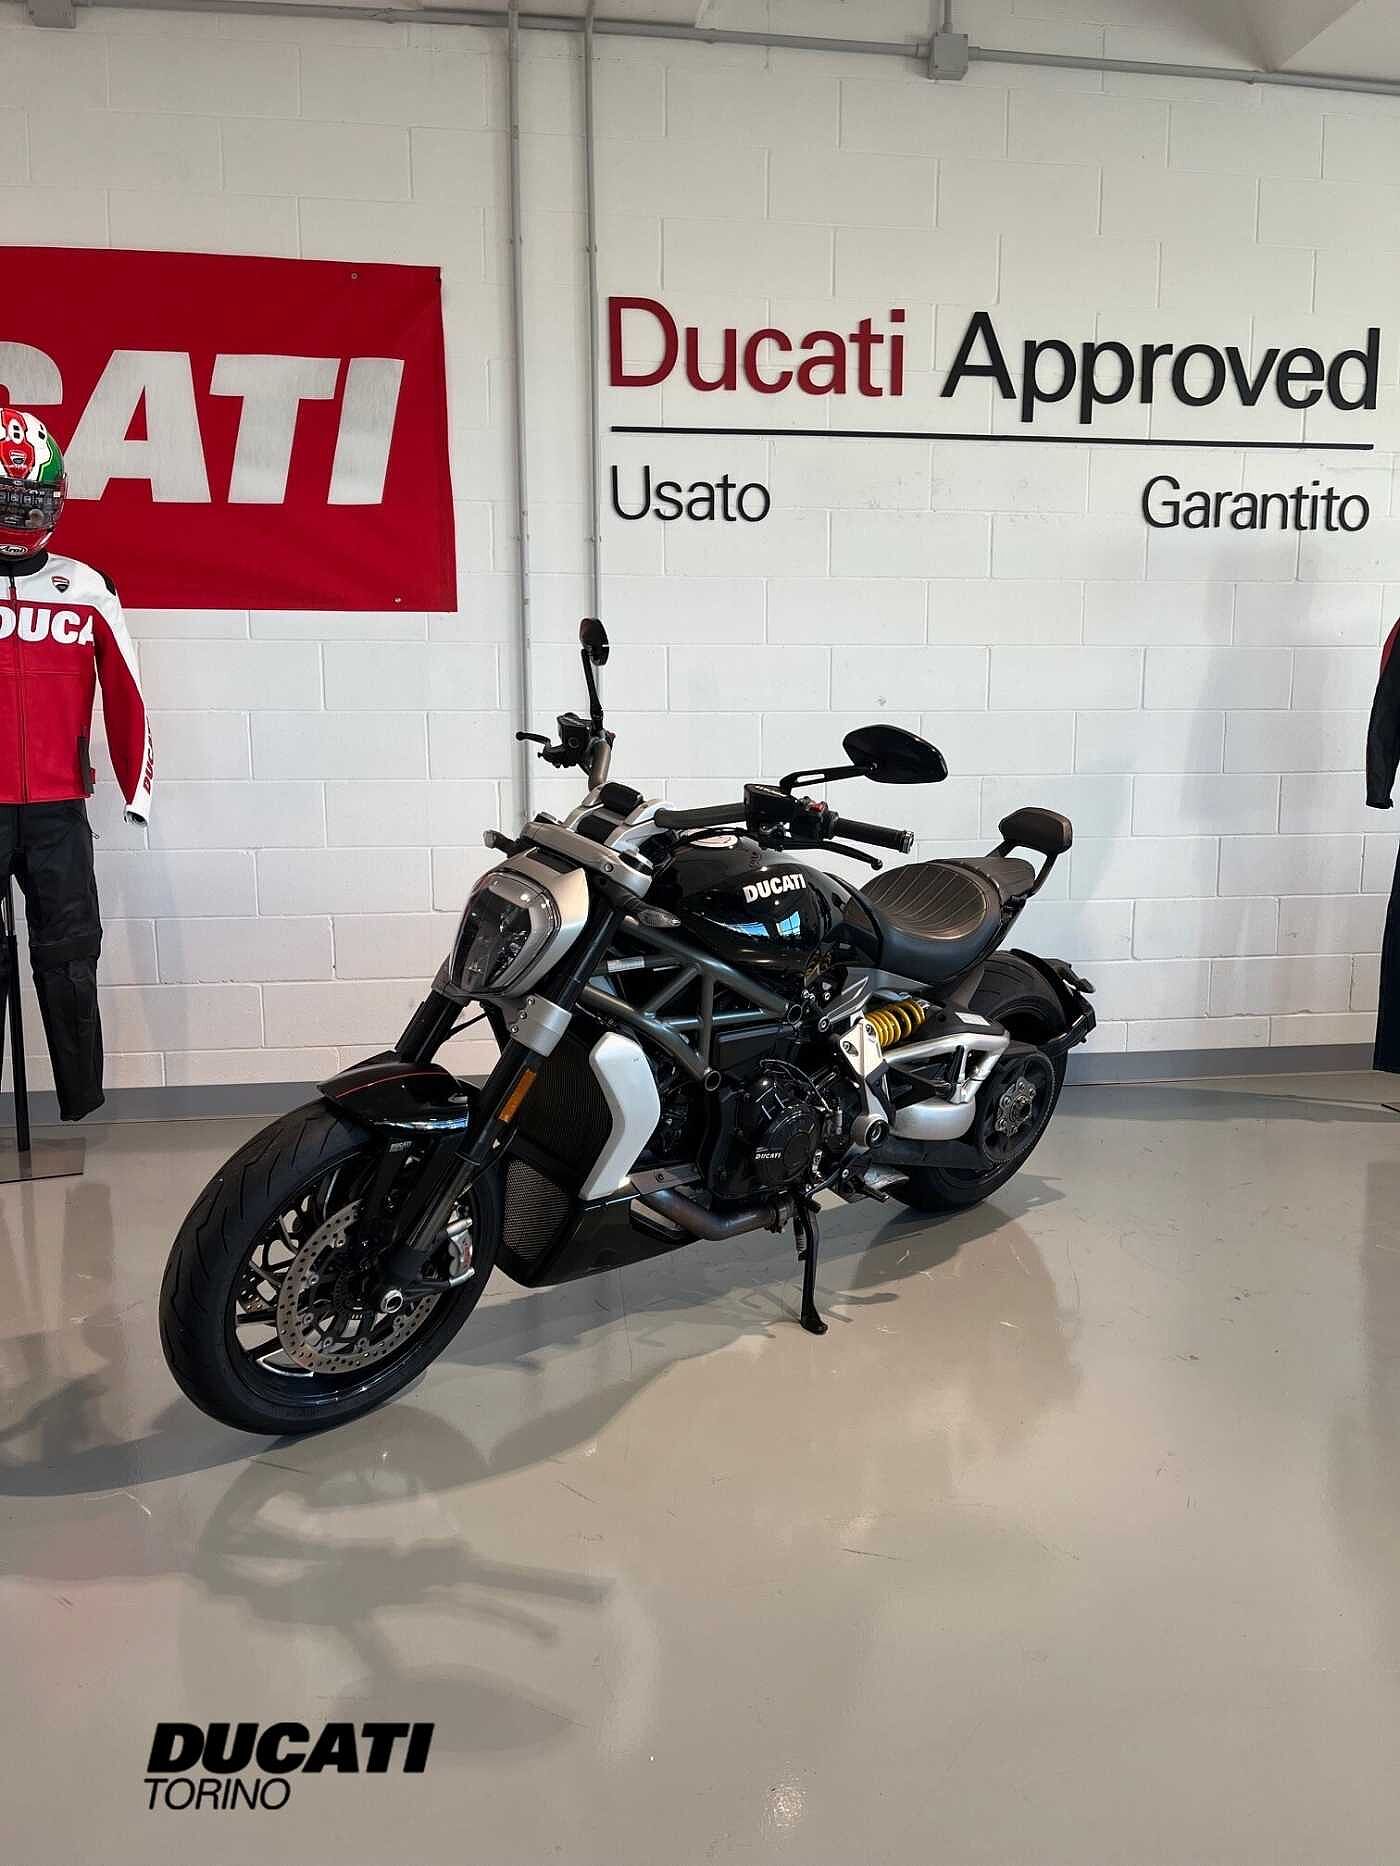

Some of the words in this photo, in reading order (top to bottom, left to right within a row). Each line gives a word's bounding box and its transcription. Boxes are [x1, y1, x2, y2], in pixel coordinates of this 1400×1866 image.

[608, 296, 905, 397] Ducati
[940, 311, 1381, 425] Approved
[611, 465, 771, 523] Usato
[1142, 475, 1370, 532] Garantito
[742, 873, 807, 904] DUCATI
